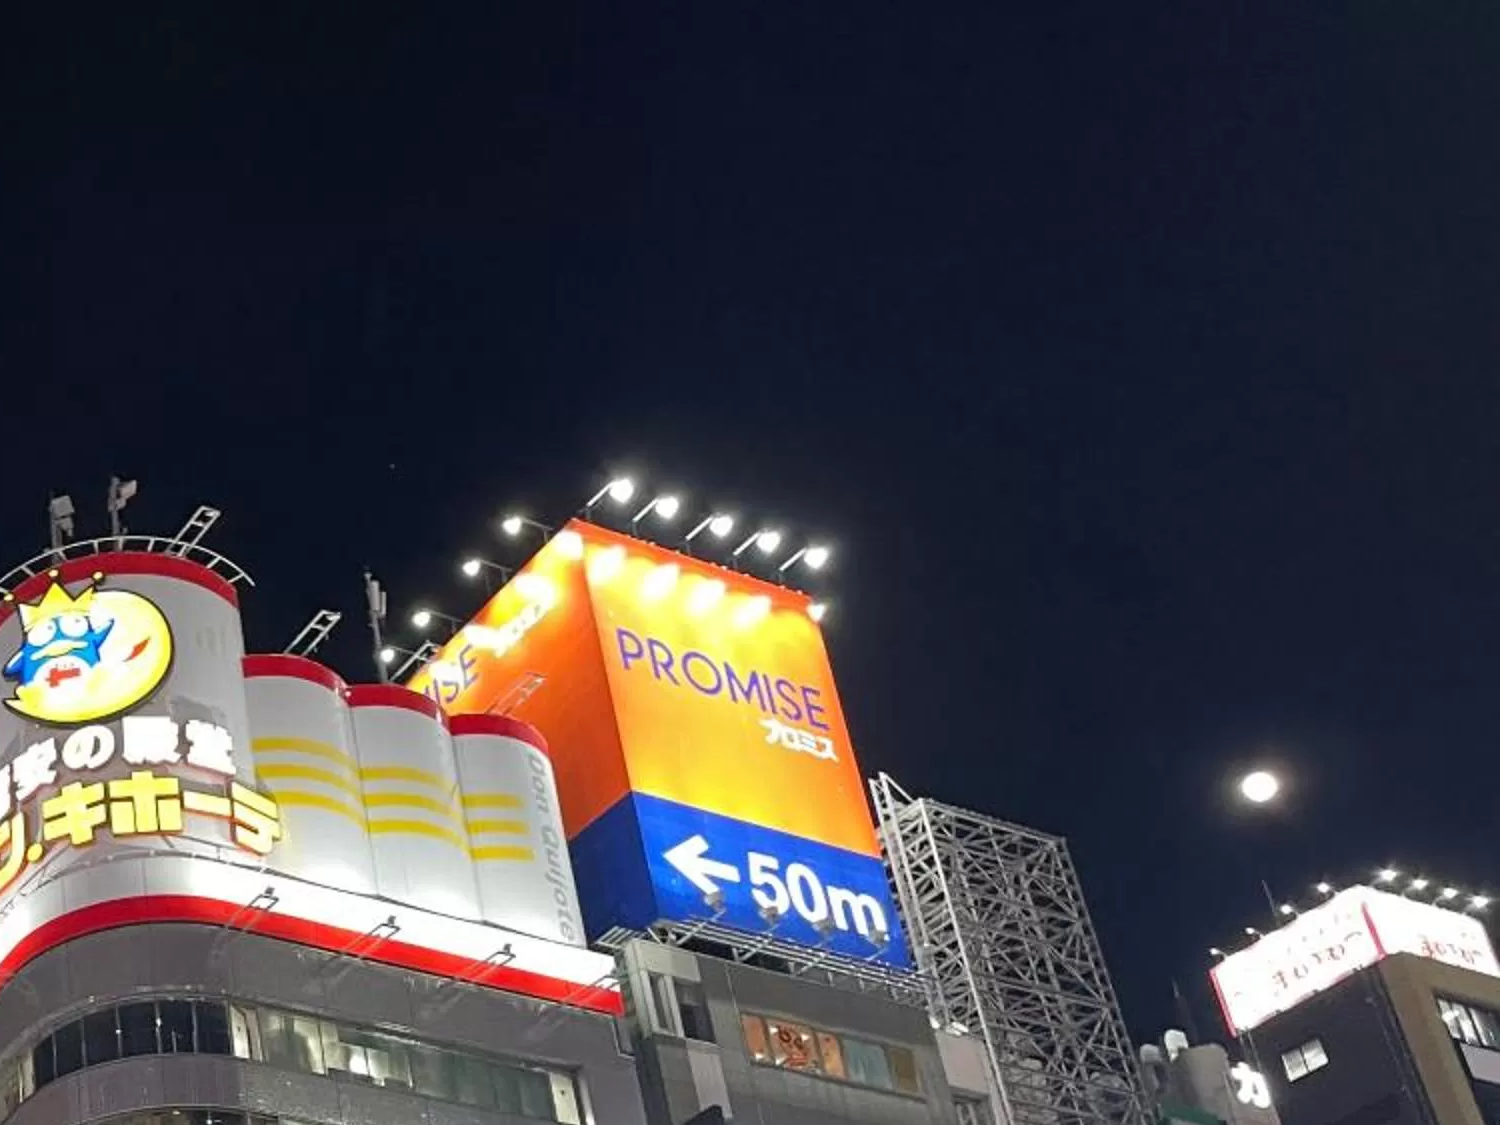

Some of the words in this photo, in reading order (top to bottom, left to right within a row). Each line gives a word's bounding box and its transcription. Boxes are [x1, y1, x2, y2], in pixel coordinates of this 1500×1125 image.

[616, 627, 831, 732] PROMISE
[760, 718, 839, 762] プロミス
[529, 755, 550, 812] Don
[543, 826, 578, 945] Quijote
[747, 851, 890, 943] 50m
